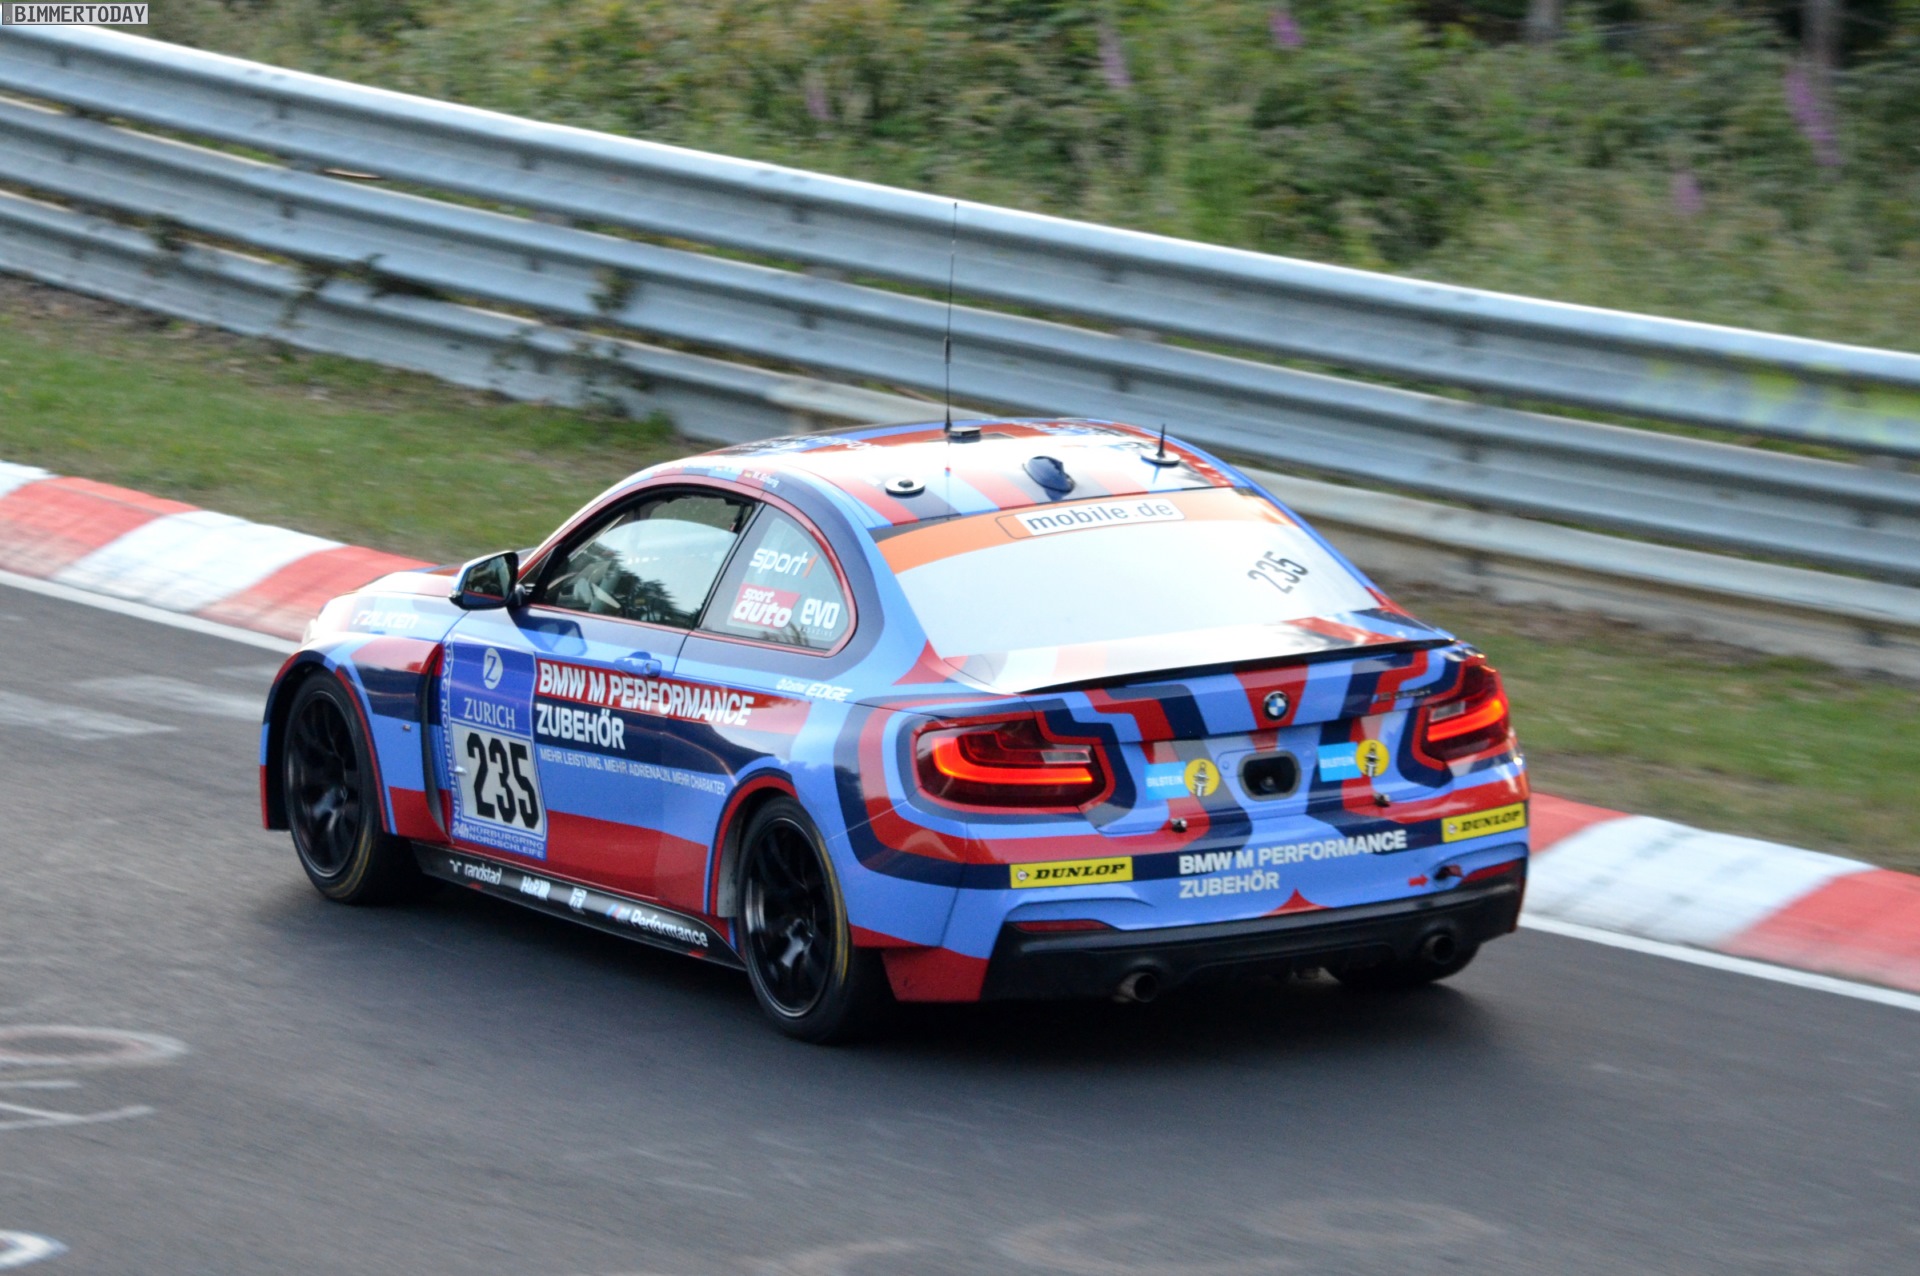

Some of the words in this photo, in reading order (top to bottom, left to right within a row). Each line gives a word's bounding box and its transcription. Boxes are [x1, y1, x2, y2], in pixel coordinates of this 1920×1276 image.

[1026, 502, 1174, 531] mobile.de
[1247, 551, 1309, 595] 235
[733, 600, 793, 628] auto
[800, 598, 841, 630] evo
[538, 662, 587, 699] BMW
[587, 671, 606, 704] M
[607, 674, 755, 726] PERFORMANCE
[805, 682, 855, 701] EDGE
[463, 697, 516, 730] ZURICH
[536, 703, 626, 750] ZUBEHÖR
[540, 747, 563, 765] MEHR
[604, 758, 628, 775] MEHR
[466, 732, 539, 830] 235
[1461, 810, 1520, 832] DUNLOP
[468, 834, 544, 859] NORDSCHLEIFE
[1179, 851, 1233, 875] BMW
[1236, 848, 1254, 869] M
[1258, 829, 1408, 867] PERFORMANCE
[464, 862, 502, 885] randstad
[1034, 863, 1126, 881] DUNLOP
[1179, 869, 1280, 899] ZUBEHÖR
[630, 909, 709, 948] Performance
